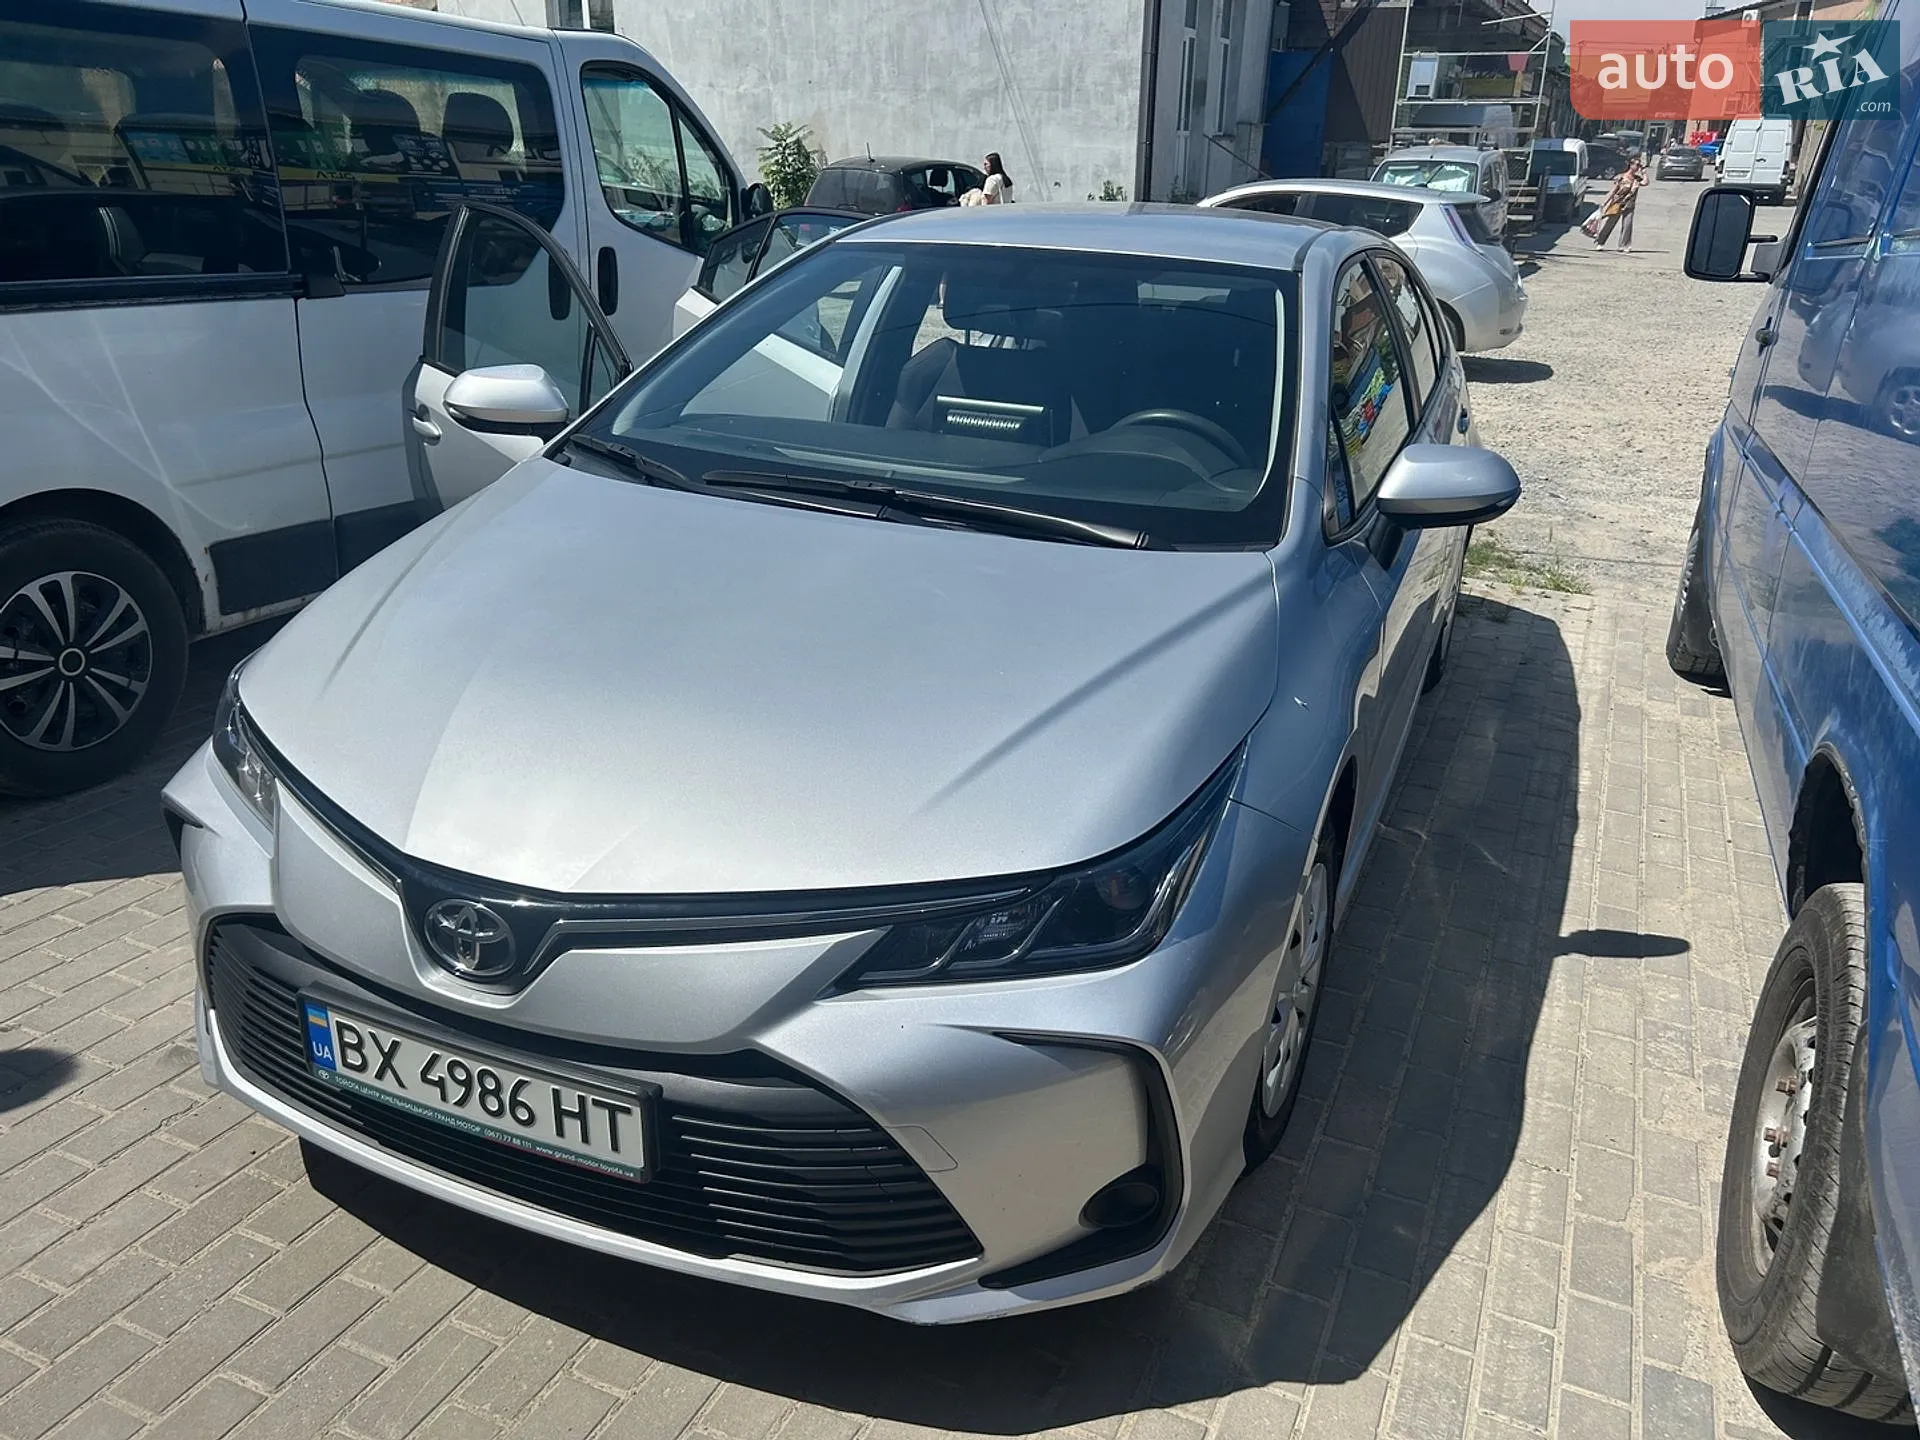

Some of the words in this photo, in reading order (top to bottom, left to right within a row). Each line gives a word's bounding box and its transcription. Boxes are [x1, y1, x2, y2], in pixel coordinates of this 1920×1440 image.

[312, 1040, 333, 1061] UA
[335, 1018, 406, 1090] BX
[417, 1050, 537, 1127] 4986
[550, 1085, 633, 1153] HT
